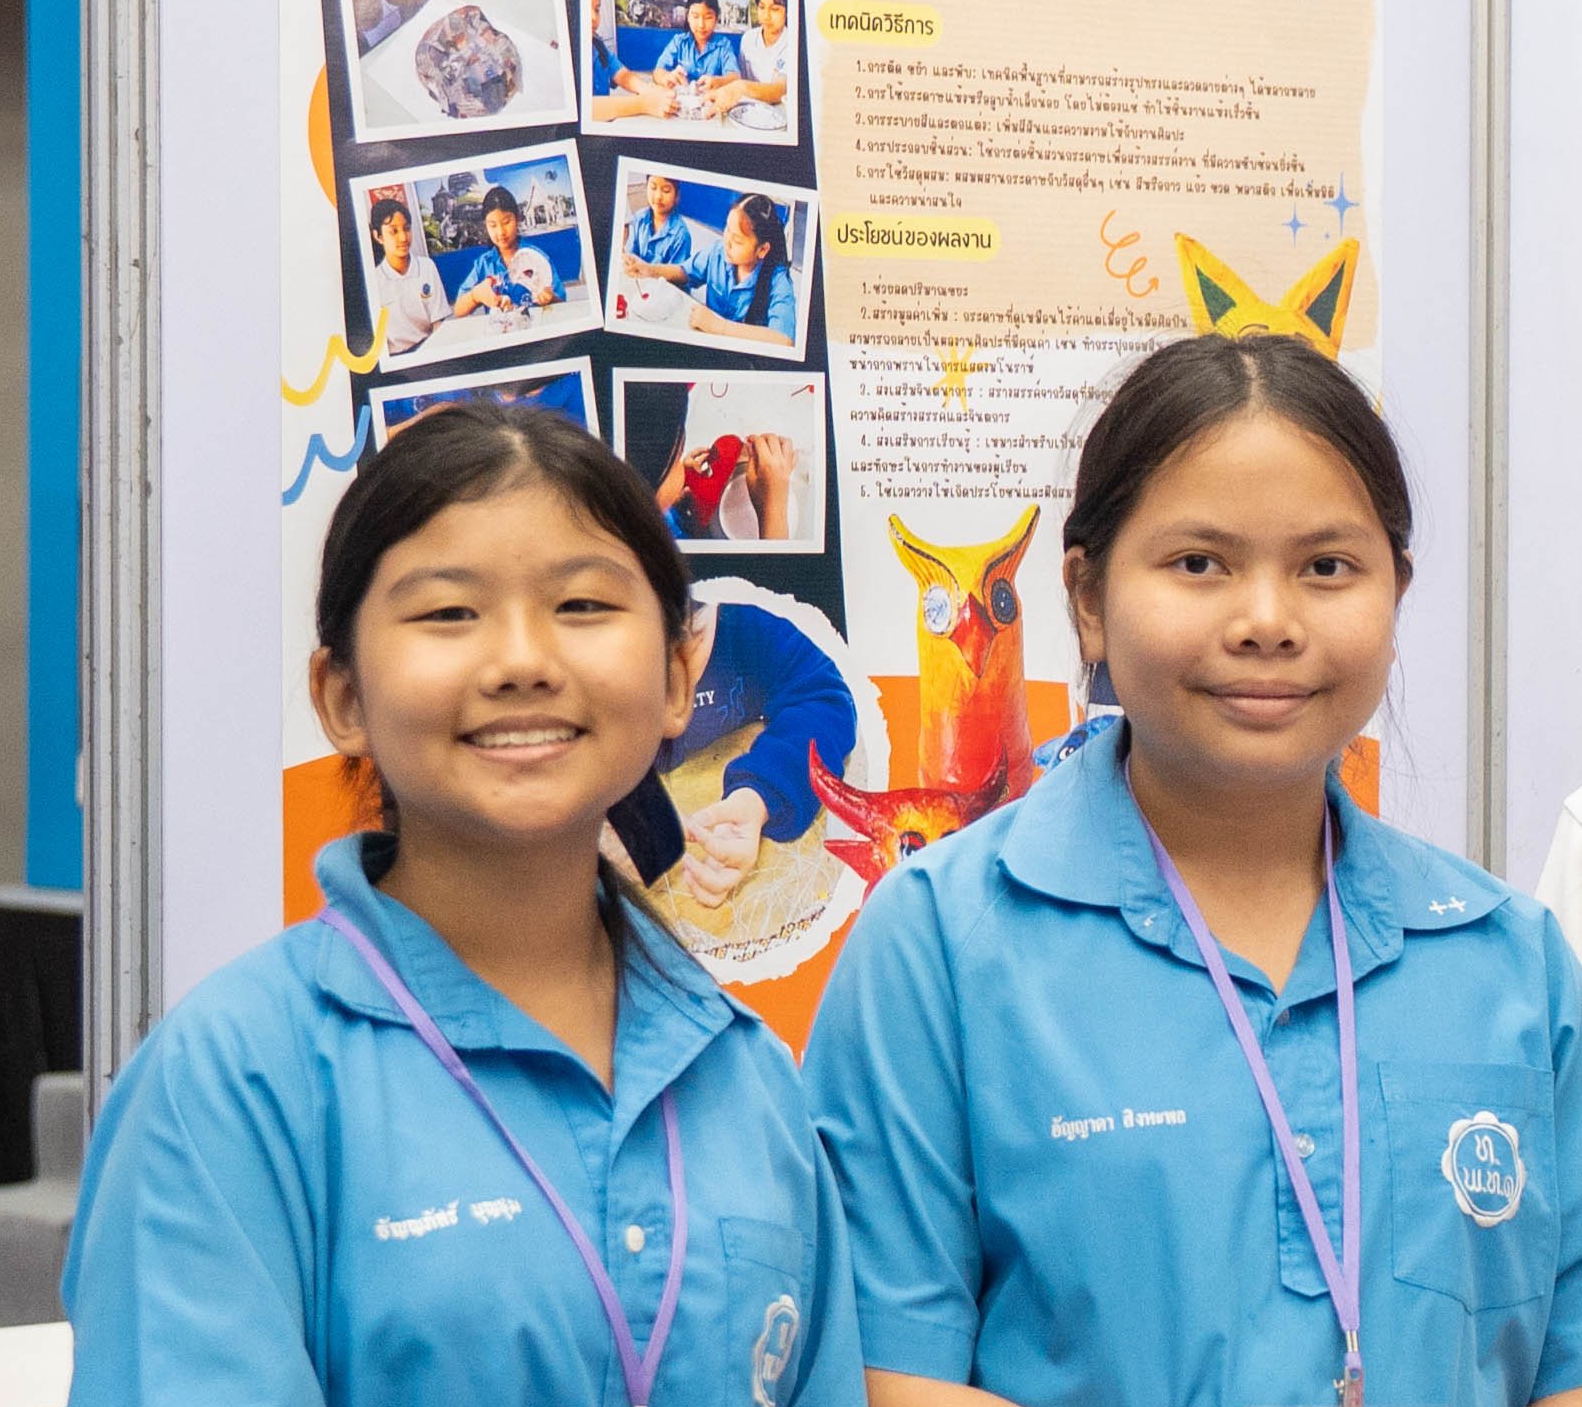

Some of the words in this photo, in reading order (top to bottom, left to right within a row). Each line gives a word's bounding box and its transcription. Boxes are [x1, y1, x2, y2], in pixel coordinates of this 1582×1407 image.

[830, 12, 934, 36] เทคนิควิธีการ
[837, 220, 992, 249] ประโยชน์ของผลงาน
